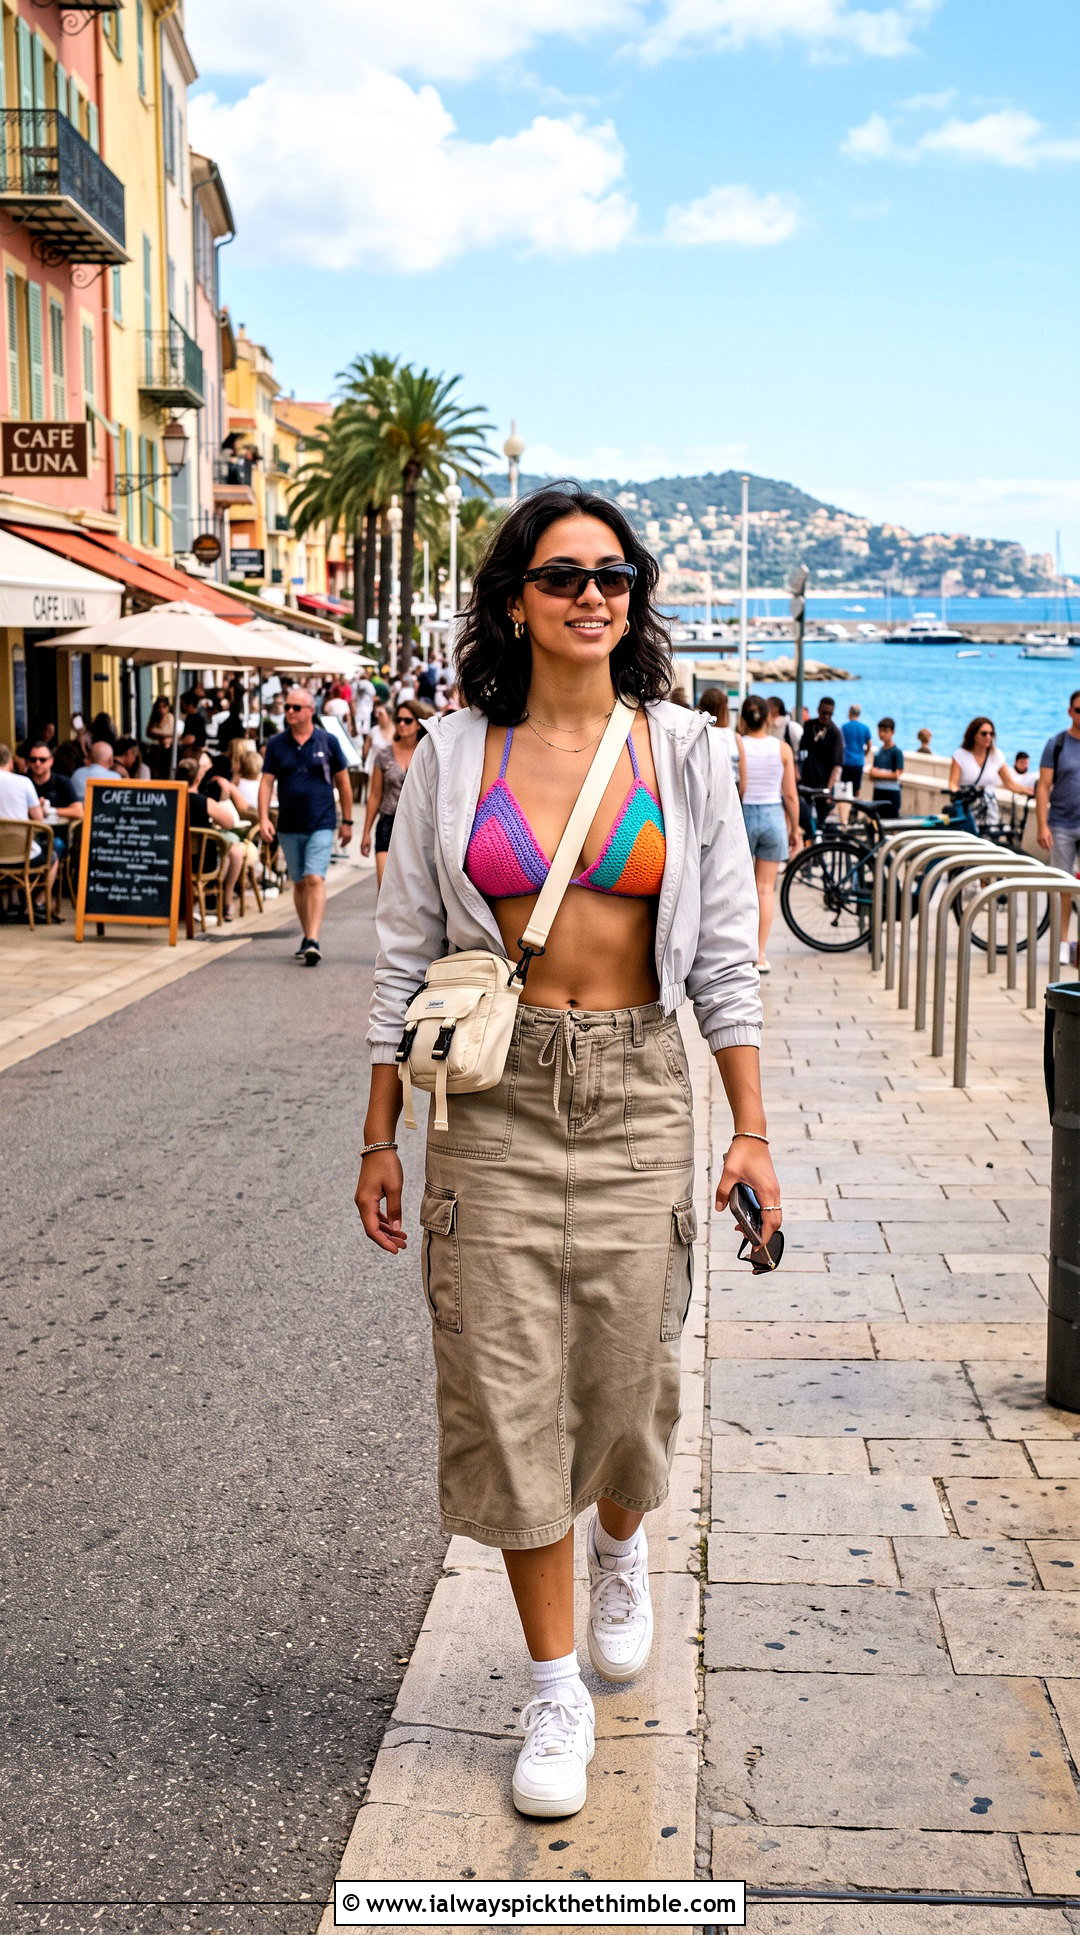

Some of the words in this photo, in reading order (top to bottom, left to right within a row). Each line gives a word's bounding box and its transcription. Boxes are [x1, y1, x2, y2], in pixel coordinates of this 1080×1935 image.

[11, 453, 79, 473] LUNA
[33, 595, 58, 621] CAFE
[62, 597, 87, 621] LUNA
[136, 792, 167, 806] LUNA
